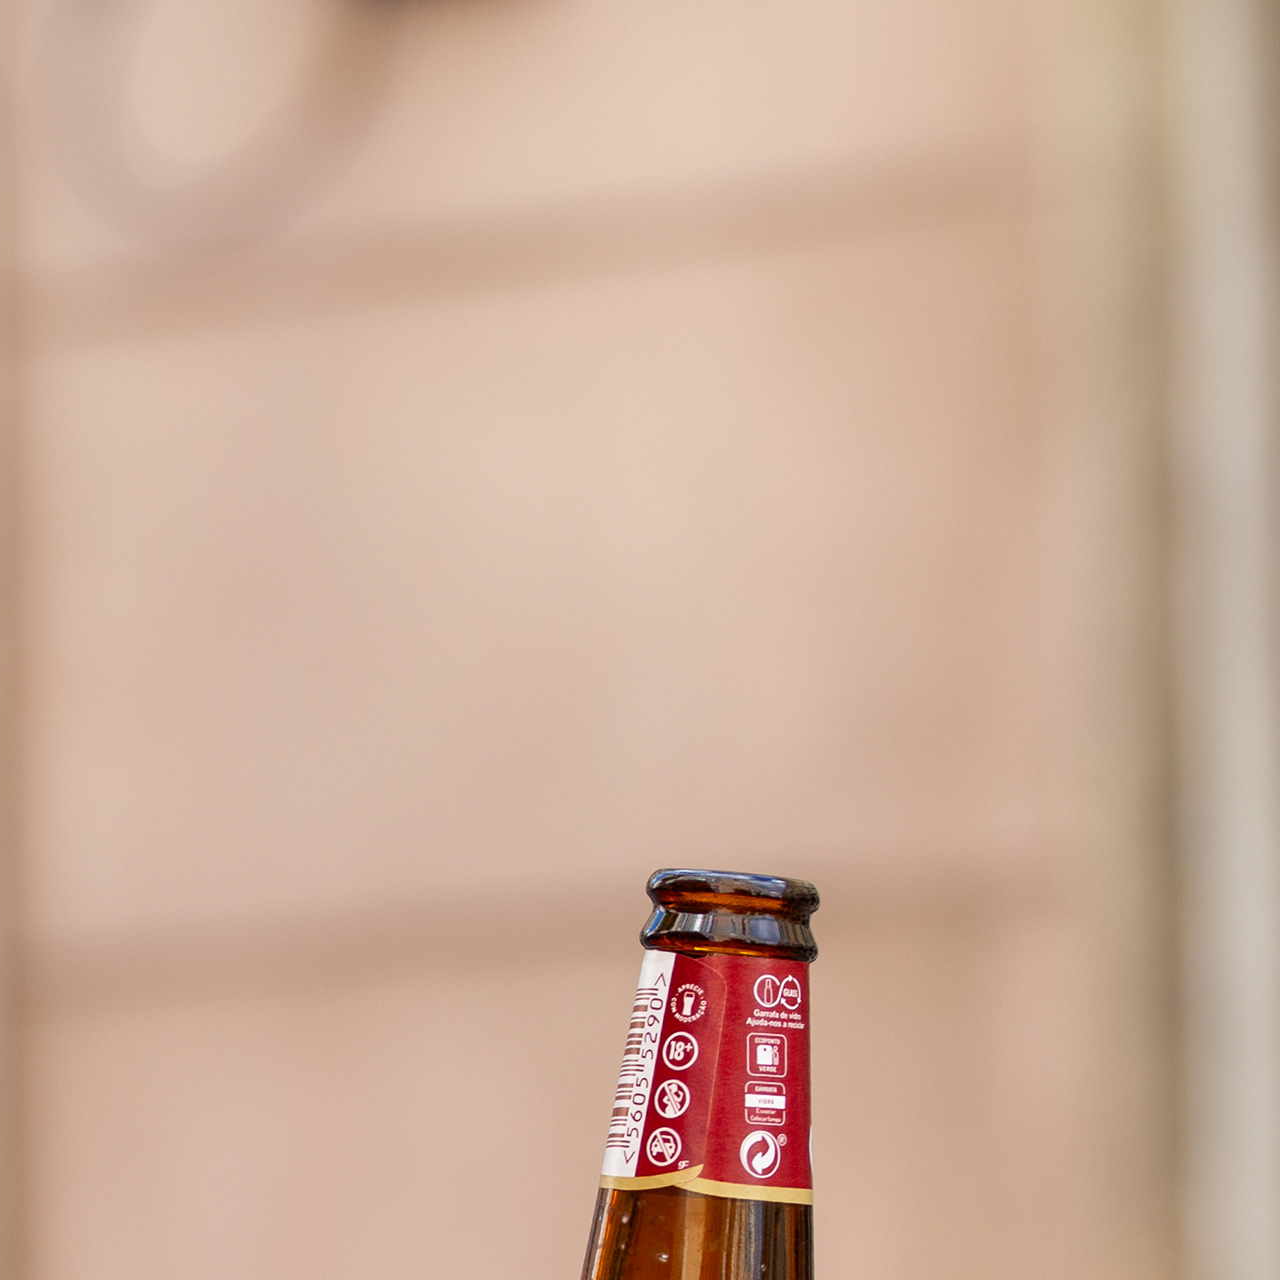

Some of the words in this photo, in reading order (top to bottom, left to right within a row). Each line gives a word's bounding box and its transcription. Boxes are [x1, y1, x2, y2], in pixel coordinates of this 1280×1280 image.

[677, 983, 705, 996] APRECIE
[668, 1040, 694, 1061] 18+
[626, 1077, 649, 1139] 5605
[641, 997, 664, 1060] 5290
